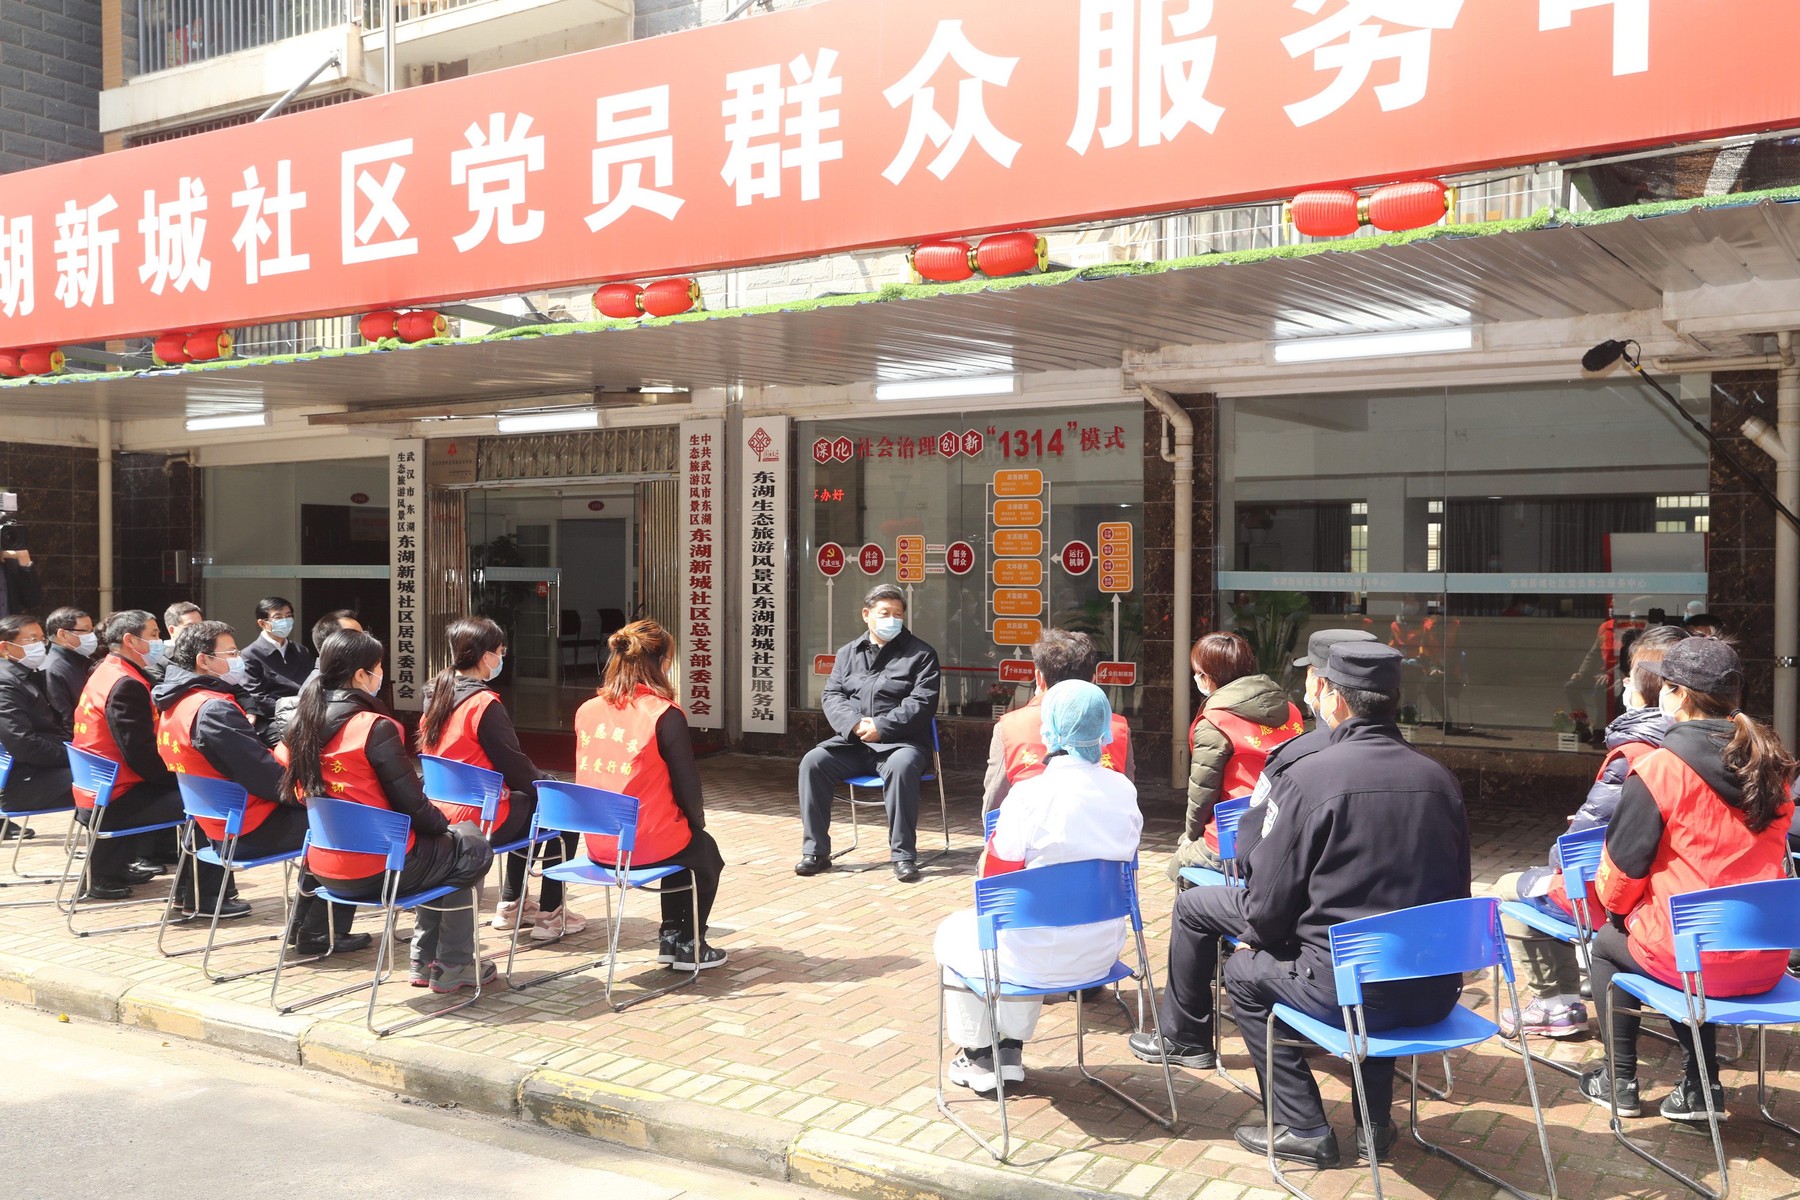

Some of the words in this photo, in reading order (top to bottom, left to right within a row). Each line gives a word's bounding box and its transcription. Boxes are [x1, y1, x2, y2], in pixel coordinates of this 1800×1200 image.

[397, 452, 405, 532] 生态旅游风景区
[406, 451, 415, 532] 武汉市东湖
[689, 434, 700, 525] 生态旅游风景区
[701, 433, 712, 525] 中共武汉市东湖
[397, 535, 416, 699] 东湖新城社区居民委员会
[689, 528, 712, 715] 东湖新城社区总支部委员会
[751, 471, 775, 720] 东湖生态旅游风景区东湖新城社区服务站
